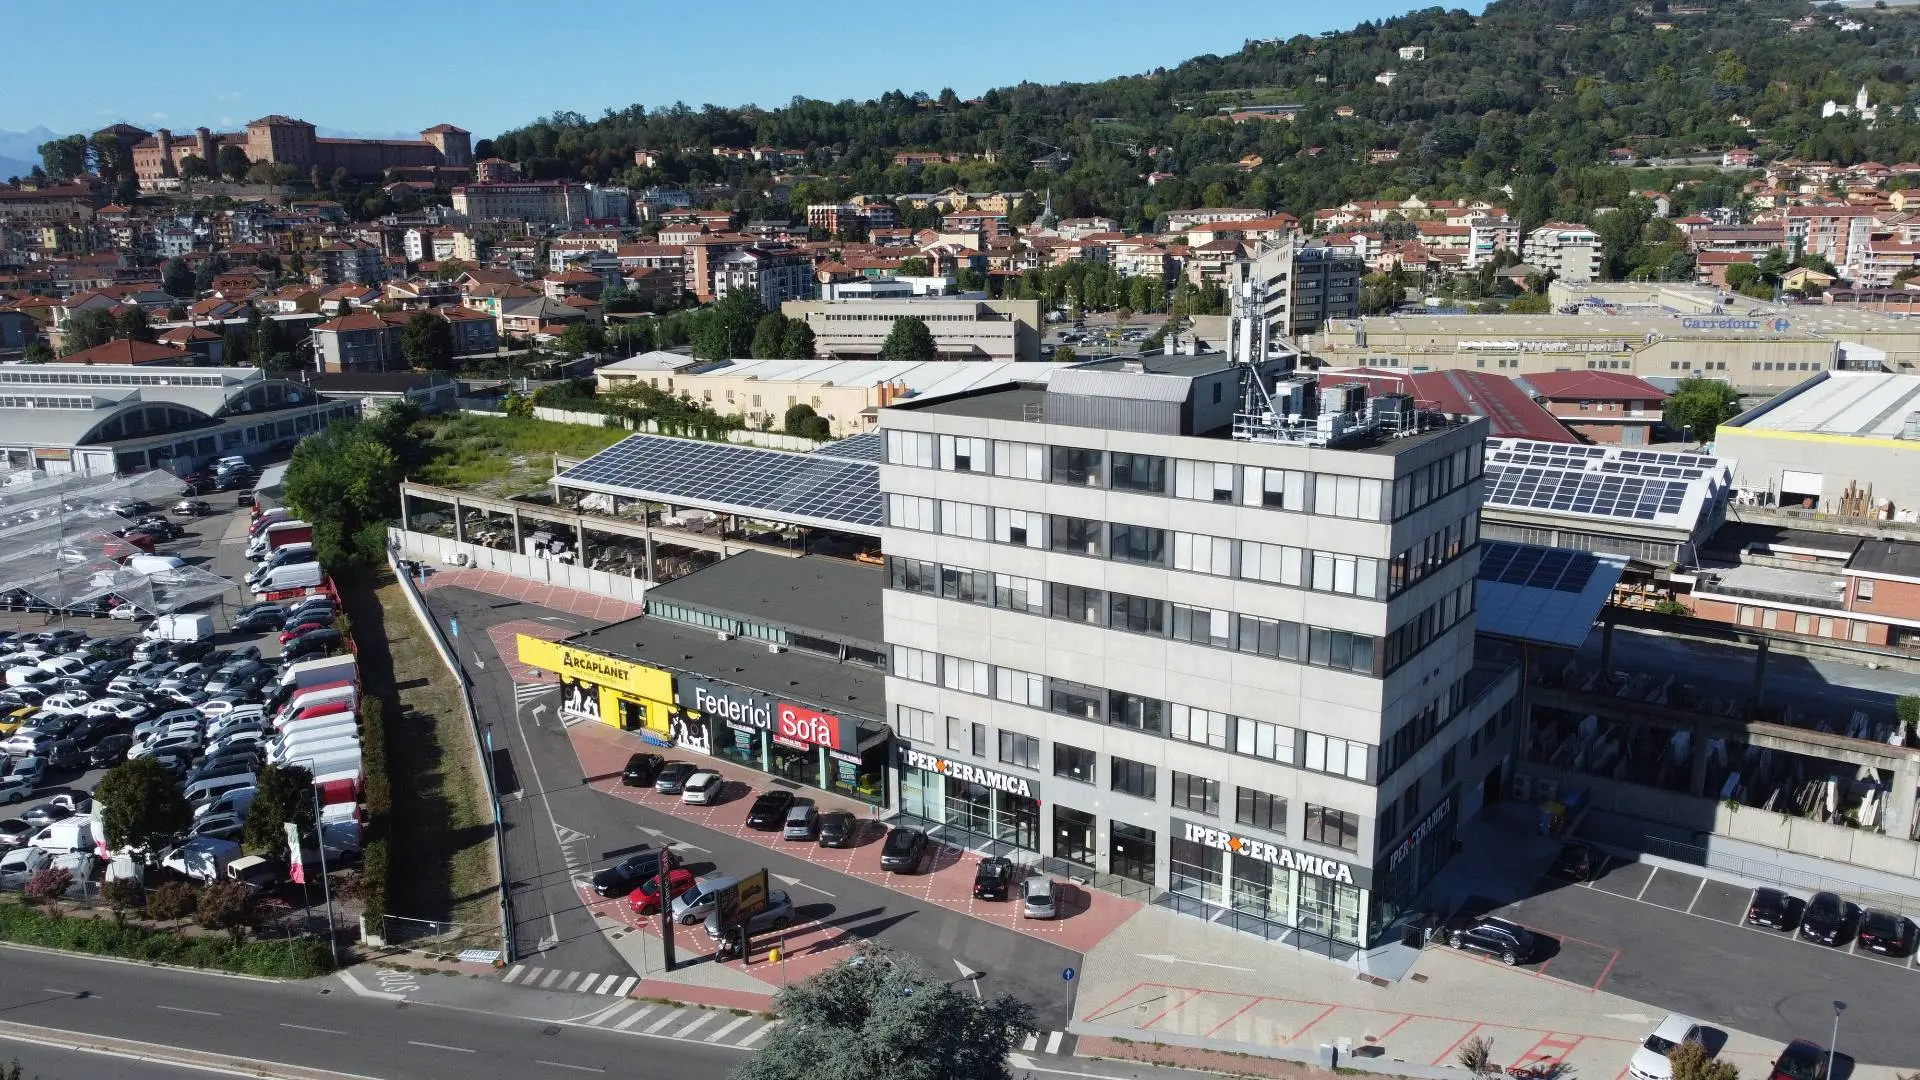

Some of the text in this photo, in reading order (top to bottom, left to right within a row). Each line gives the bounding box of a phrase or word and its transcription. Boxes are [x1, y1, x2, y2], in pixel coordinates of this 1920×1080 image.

[1682, 318, 1760, 329] Carrefour
[563, 651, 629, 680] ARCAPLANET
[695, 687, 771, 729] Federici
[782, 711, 832, 747] Sofà
